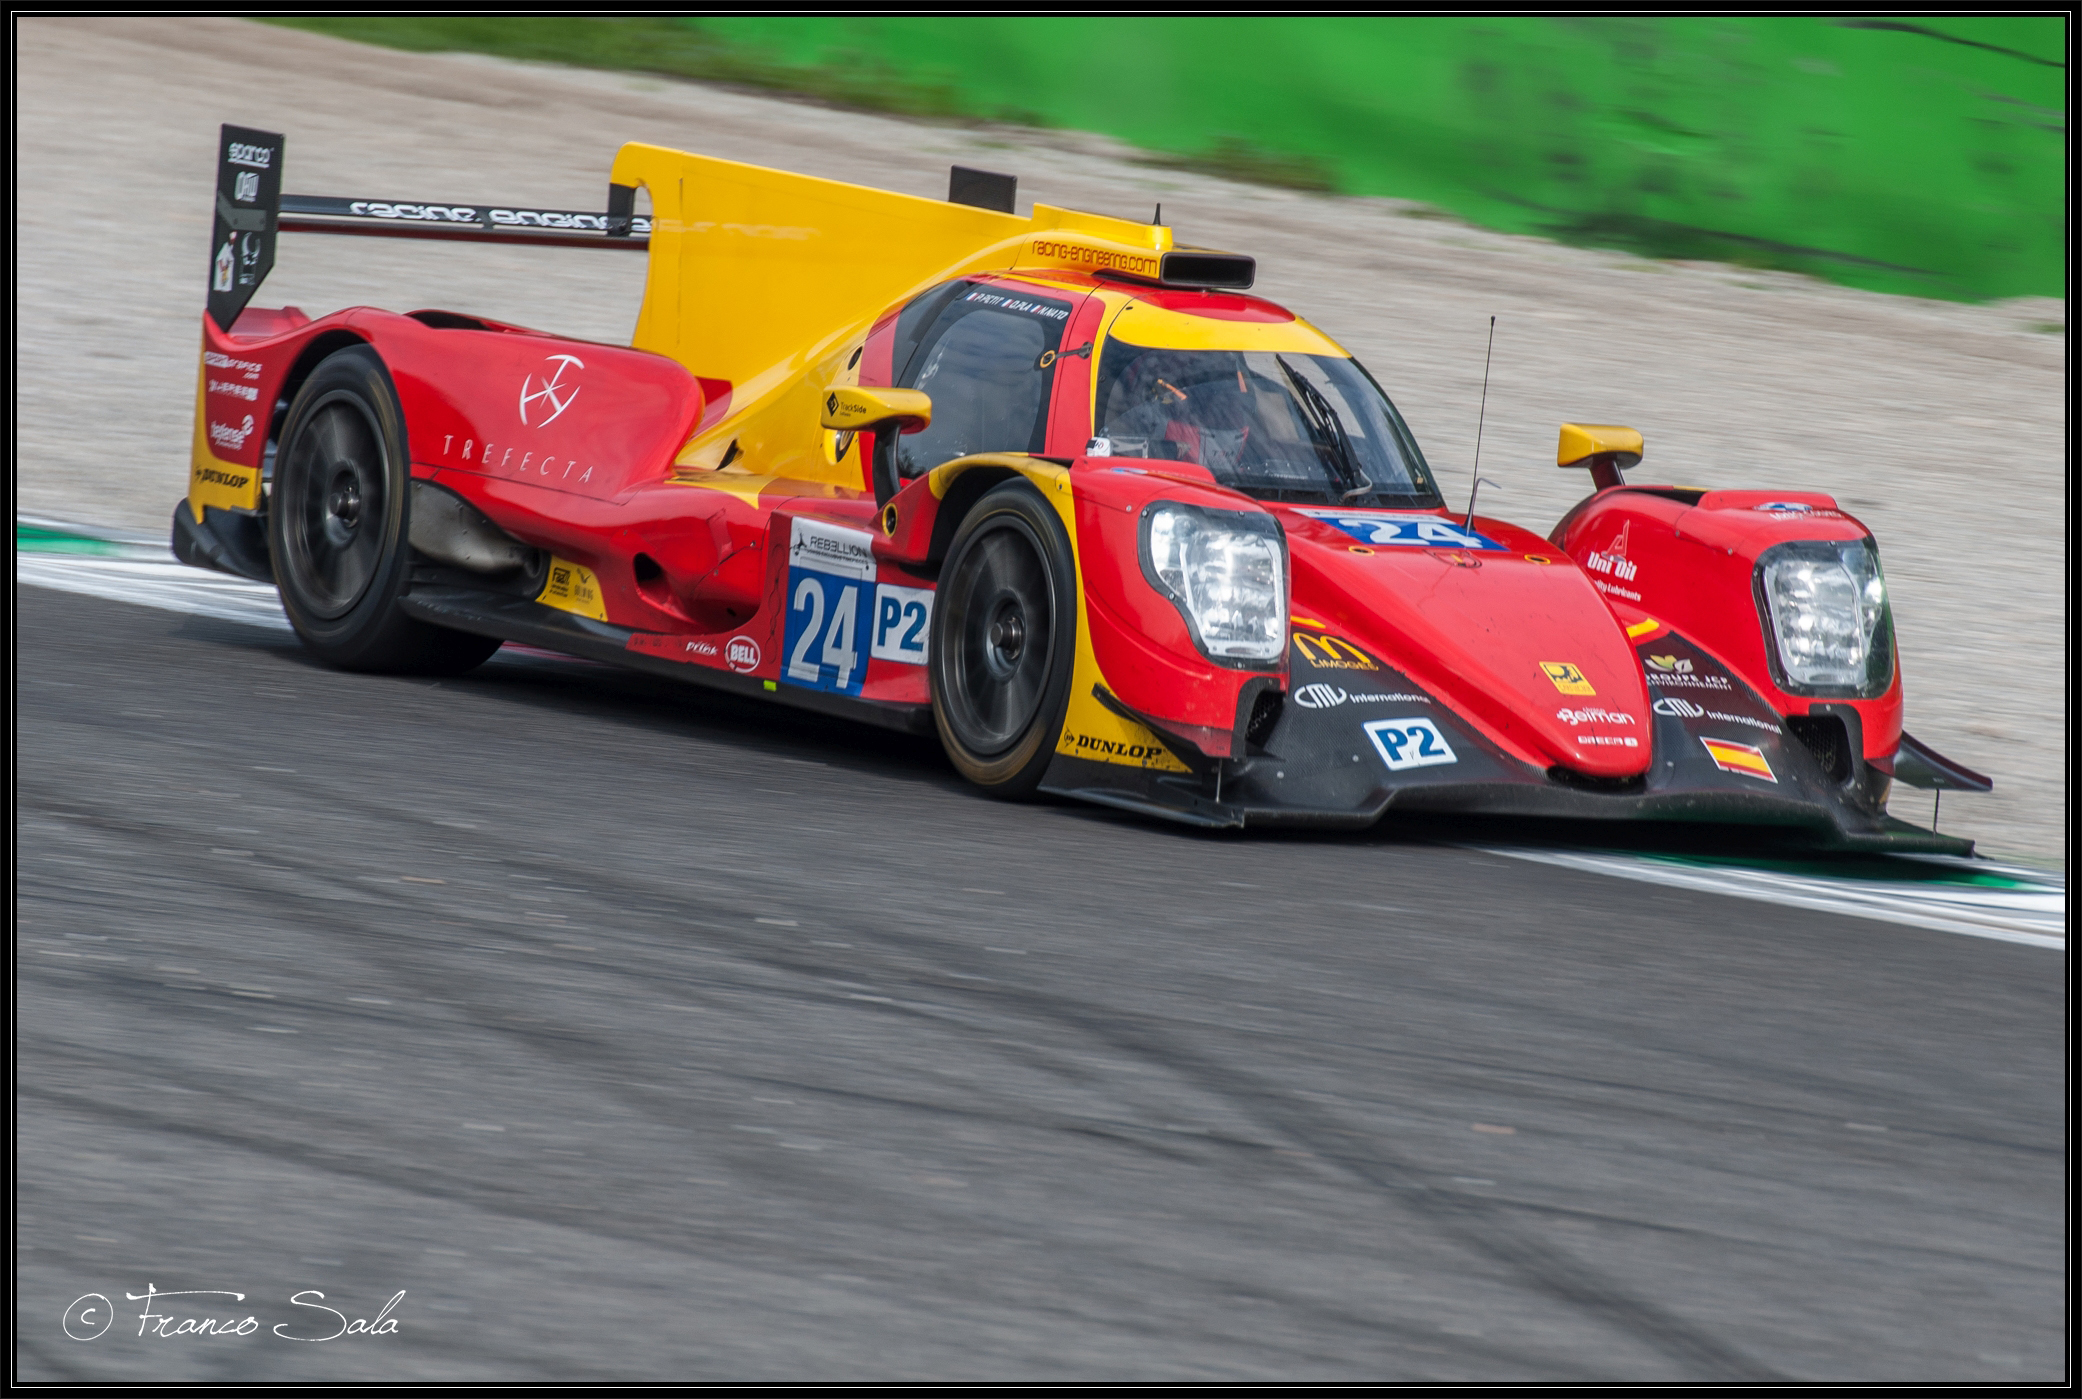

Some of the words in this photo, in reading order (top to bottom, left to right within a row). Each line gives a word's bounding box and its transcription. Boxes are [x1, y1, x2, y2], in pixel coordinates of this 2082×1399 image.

[1032, 240, 1158, 275] racing-engineering.com
[443, 434, 594, 484] TREFECTA
[1339, 518, 1483, 549] 24
[1587, 551, 1612, 574] Uni
[1614, 560, 1637, 582] Oil
[787, 577, 858, 689] 24
[877, 595, 927, 652] P2
[730, 644, 756, 664] BELL
[1310, 659, 1379, 671] LIMOGES
[1707, 710, 1783, 735] International
[1077, 734, 1162, 759] DUNLOP
[1375, 726, 1446, 762] P2
